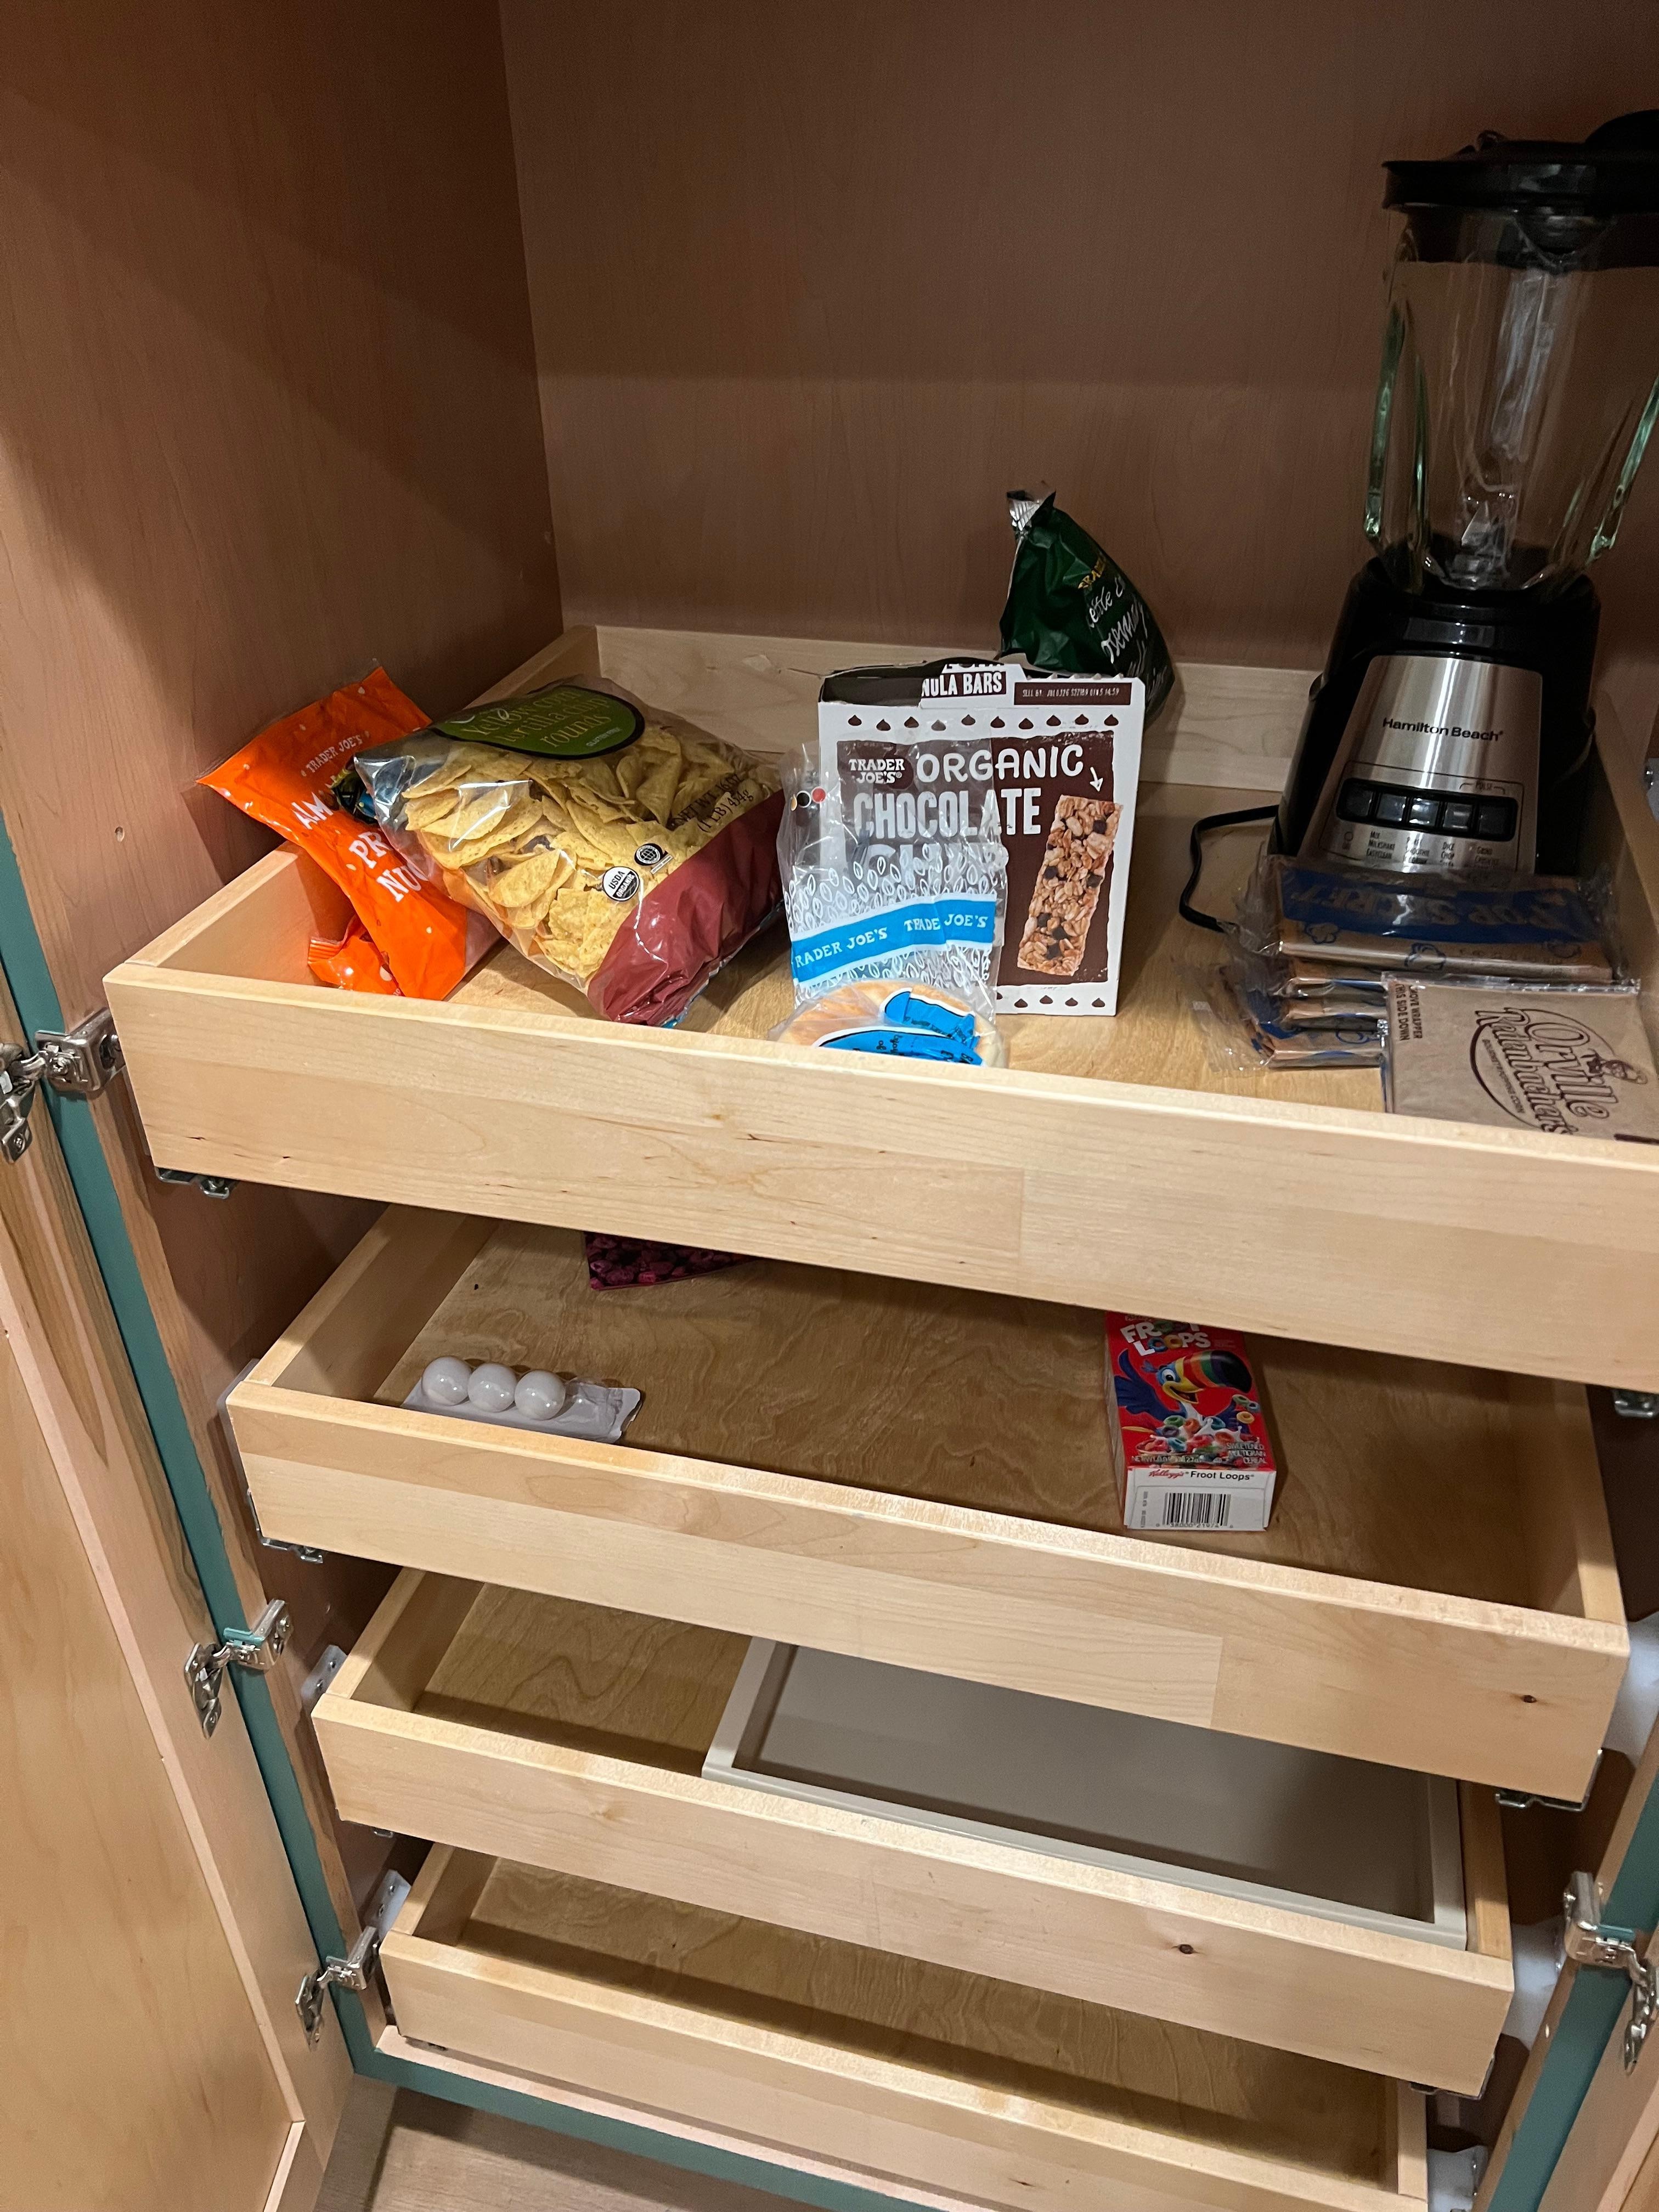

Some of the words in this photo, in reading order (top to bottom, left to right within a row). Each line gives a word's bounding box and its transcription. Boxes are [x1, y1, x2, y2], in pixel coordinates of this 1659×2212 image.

[1089, 586, 1113, 628] ettle
[963, 672, 1002, 695] BARS
[461, 706, 535, 736] Yellow
[533, 690, 582, 710] corn
[540, 712, 612, 748] rounds
[1383, 717, 1449, 736] Hamilton
[1451, 726, 1499, 741] Beach
[306, 746, 338, 774] TRADER
[338, 734, 363, 753] JOE'S
[848, 758, 905, 771] TRADER
[916, 744, 1084, 783] ORGANIC
[856, 771, 896, 784] JOE'S
[853, 787, 1041, 839] CHOCOLATE
[608, 870, 625, 889] USDA
[616, 874, 636, 899] ORGANIC
[944, 913, 988, 928] JOE'S
[795, 941, 843, 968] RADER
[846, 927, 888, 950] JOE'S
[1397, 1000, 1408, 1017] SIDE
[1398, 1018, 1410, 1041] DOWN
[1412, 1007, 1423, 1039] WRAPPER
[1525, 1022, 1619, 1119] Orville
[1133, 1332, 1211, 1357] LOOPS
[1191, 1471, 1216, 1480] Froot
[1220, 1471, 1250, 1481] Loops
